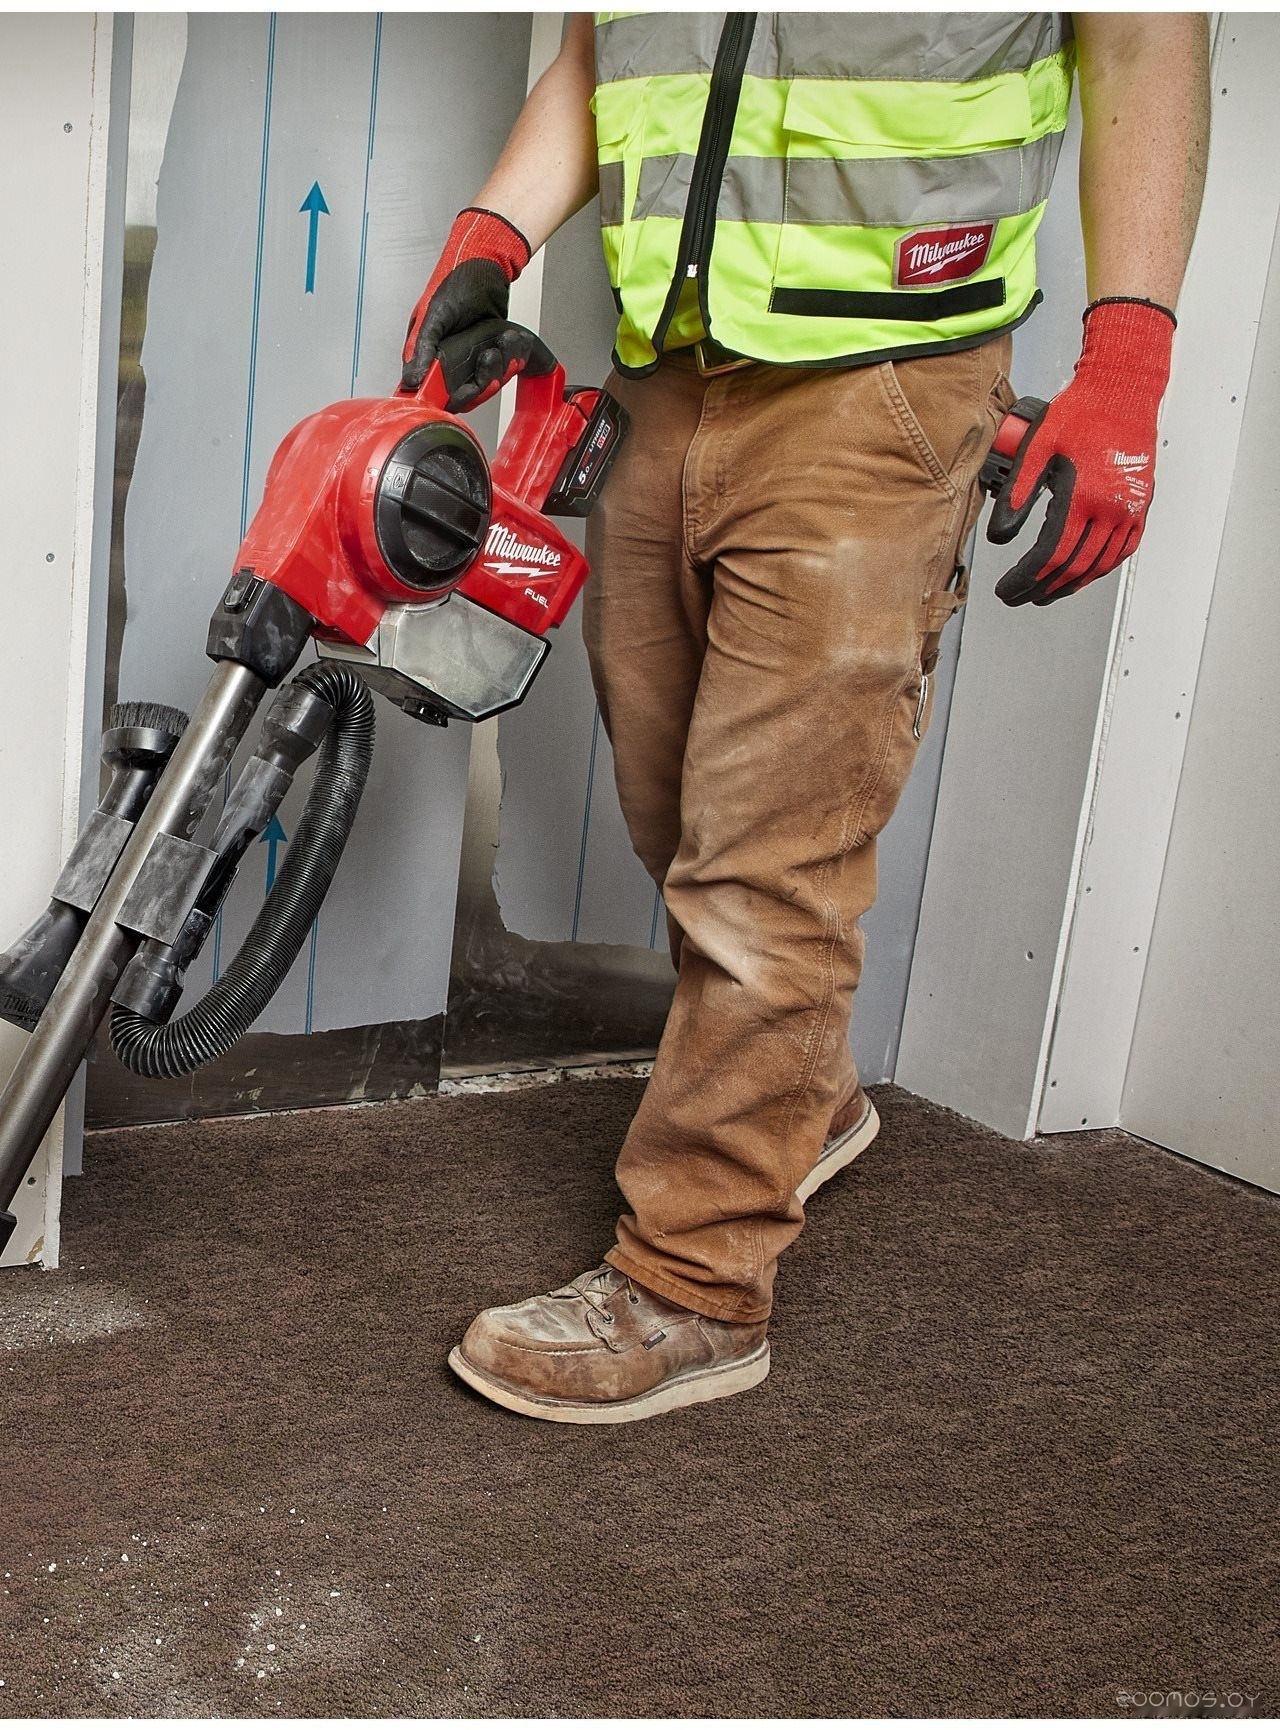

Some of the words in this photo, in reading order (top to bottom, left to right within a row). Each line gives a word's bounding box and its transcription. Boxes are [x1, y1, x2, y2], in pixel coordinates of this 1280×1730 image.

[904, 232, 986, 270] Milwaukee
[483, 522, 562, 567] Milwaukee
[523, 587, 550, 609] FUEL
